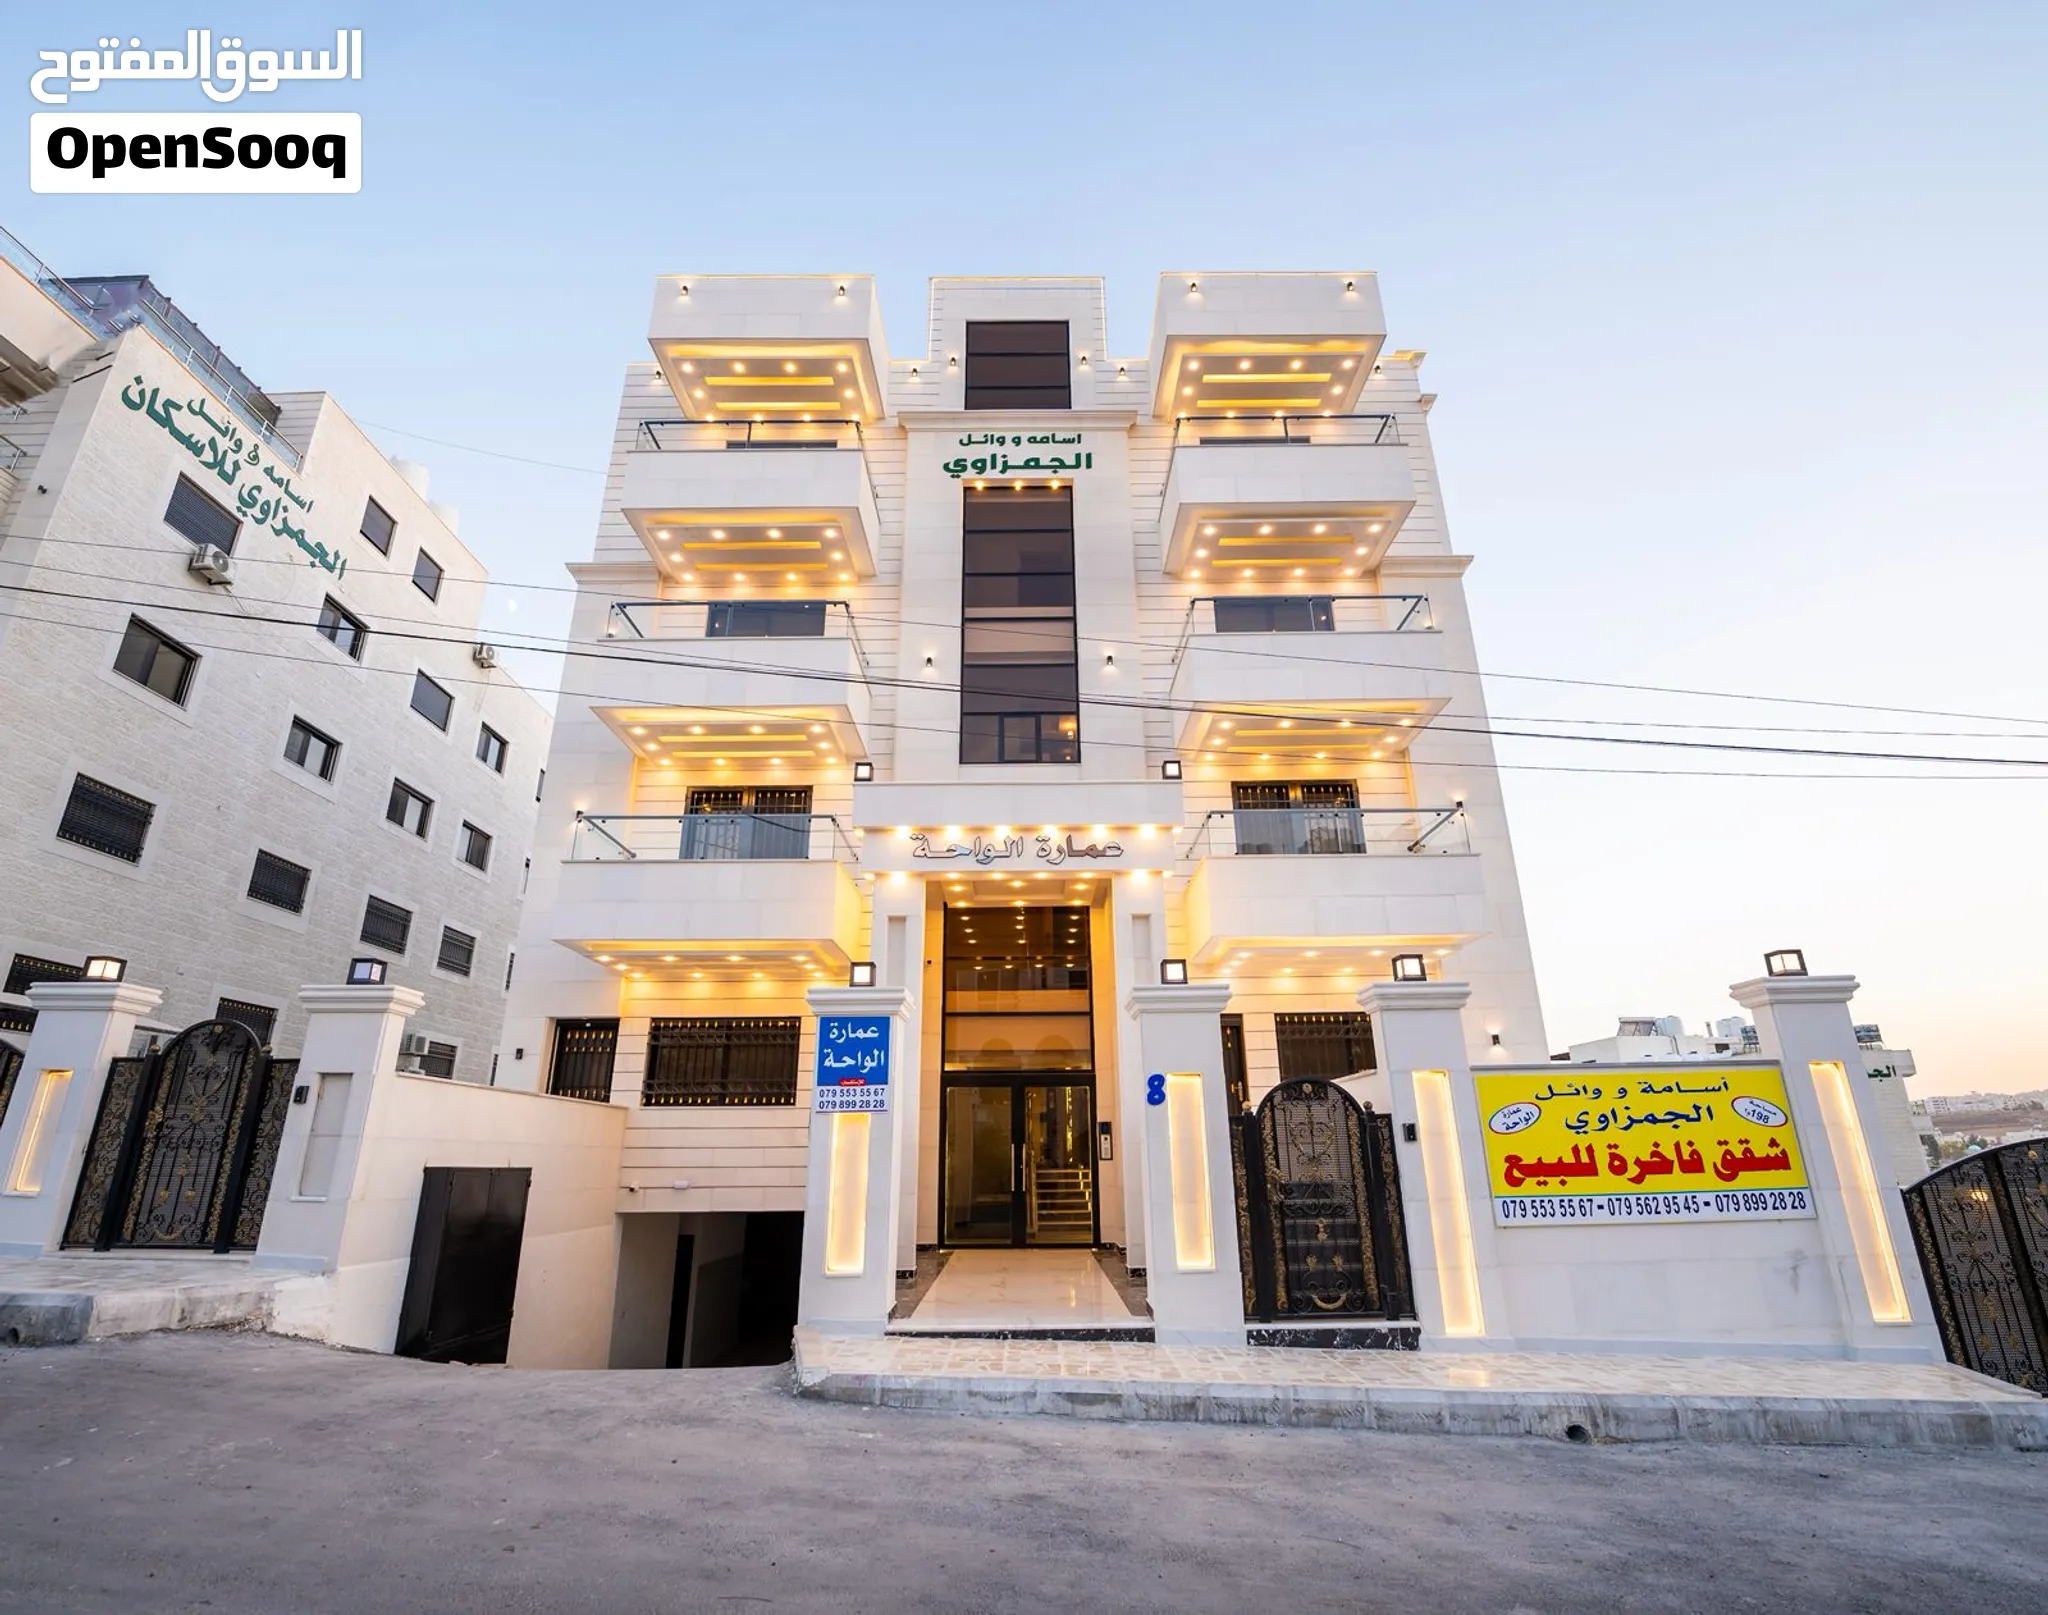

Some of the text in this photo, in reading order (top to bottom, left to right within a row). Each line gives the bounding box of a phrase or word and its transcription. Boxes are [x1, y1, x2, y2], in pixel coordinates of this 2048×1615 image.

[959, 433, 1082, 447] اسامه و وائل
[943, 452, 1093, 479] الجمزاوي
[236, 483, 347, 580] الجمزاوي
[909, 833, 1124, 866] عمارة الواحة
[829, 1022, 880, 1044] عمارة
[823, 1048, 885, 1073] الواحة
[819, 1088, 885, 1098] 079 553 55 67
[1147, 1073, 1166, 1106] 8
[1534, 1076, 1730, 1101] أسامة و وائل
[819, 1099, 885, 1110] 079 899 28 28
[1501, 1107, 1522, 1119] عمارة
[1501, 1111, 1535, 1131] الواحة
[1564, 1104, 1714, 1135] الجمزاوي
[1502, 1137, 1792, 1188] شقق فاخرة للبيع
[1502, 1199, 1527, 1219] 079
[1530, 1198, 1556, 1218] 553
[1559, 1198, 1576, 1218] 55
[1579, 1198, 1594, 1217] 67
[1607, 1196, 1632, 1216] 079
[1636, 1195, 1661, 1216] 562
[1664, 1195, 1681, 1215] 95
[1683, 1194, 1700, 1214] 45
[1715, 1193, 1740, 1213] 079
[1744, 1192, 1768, 1212] 899
[1770, 1191, 1787, 1211] 28
[1789, 1191, 1806, 1210] 28
